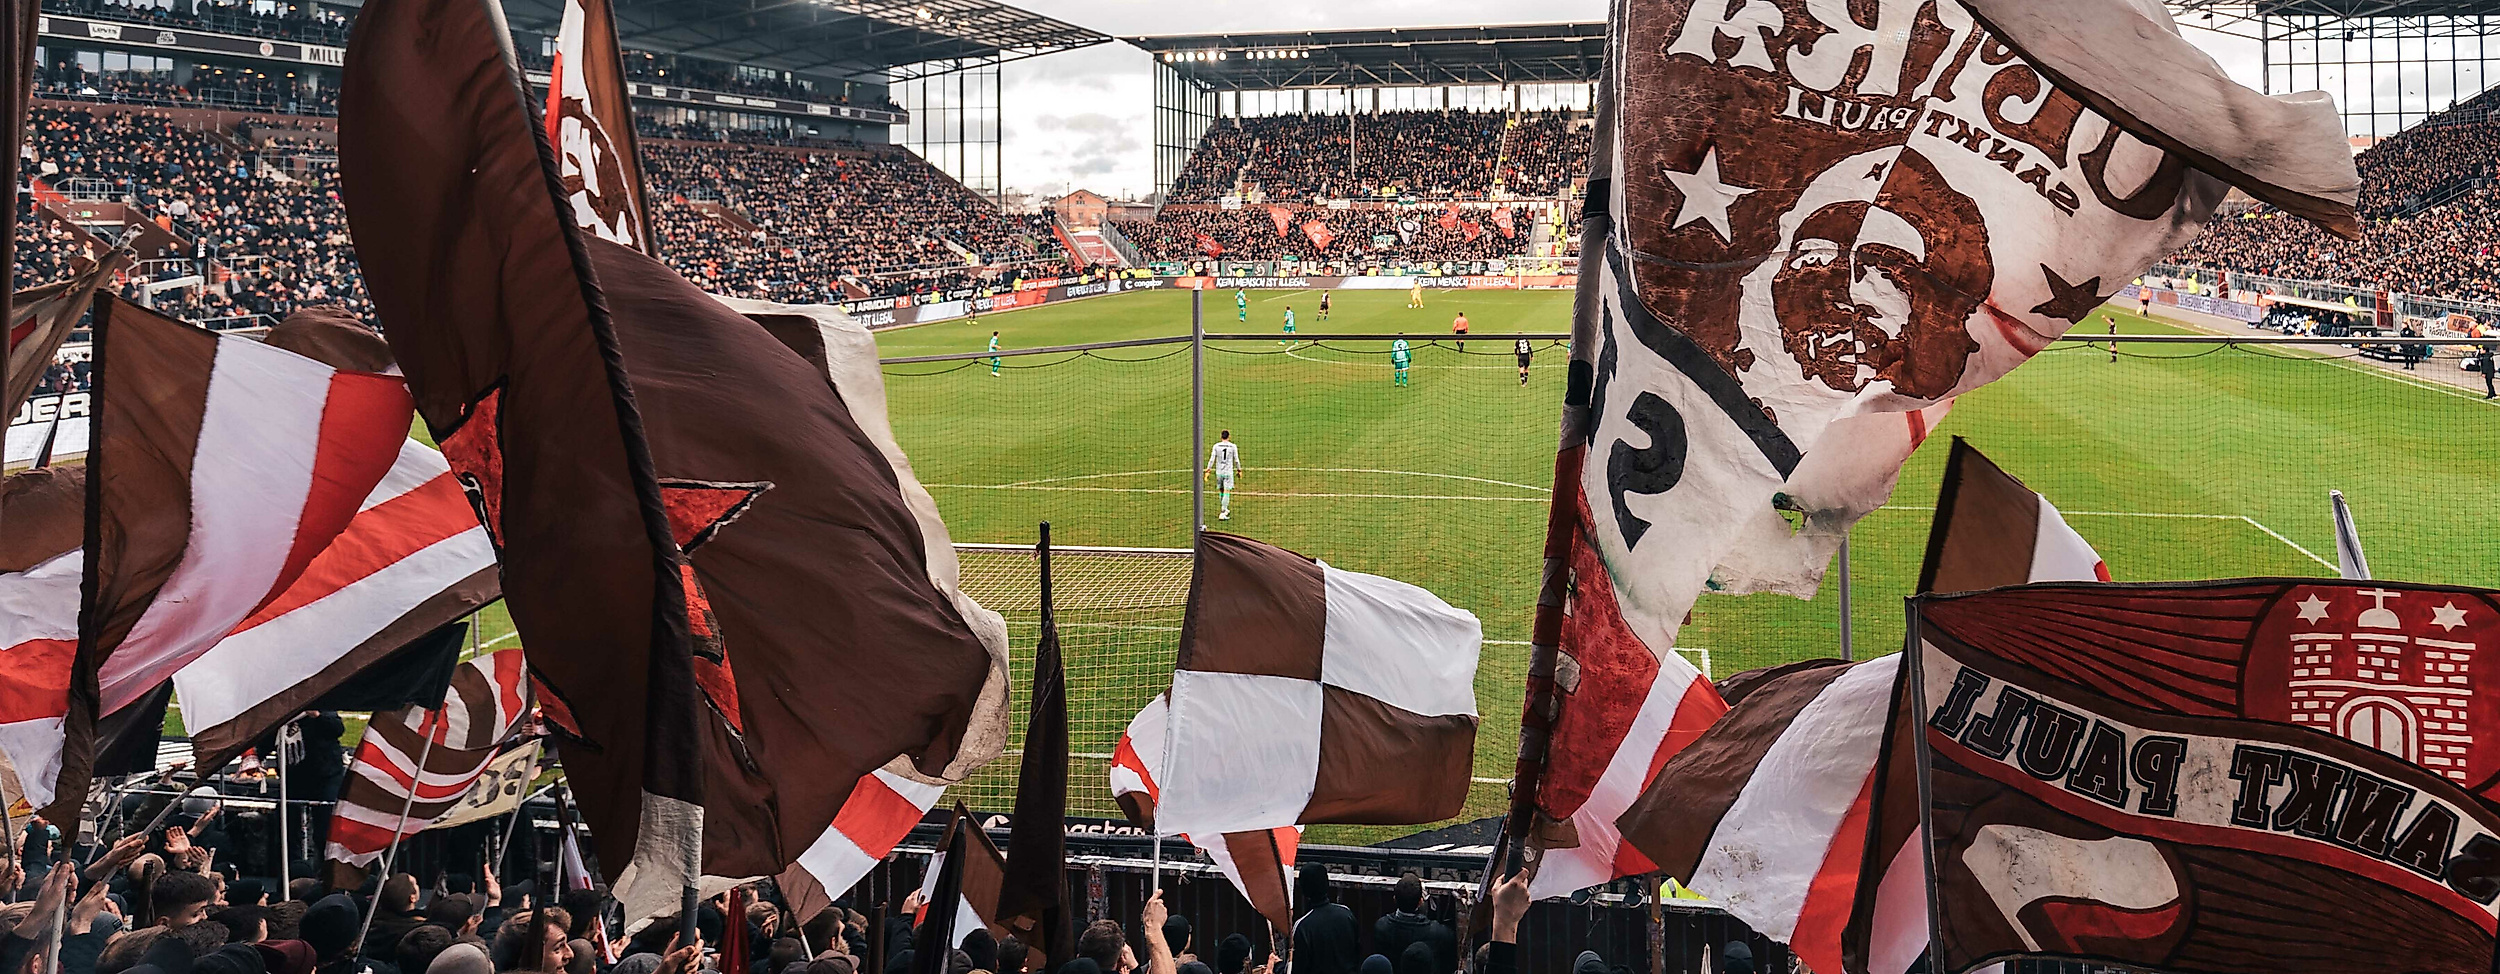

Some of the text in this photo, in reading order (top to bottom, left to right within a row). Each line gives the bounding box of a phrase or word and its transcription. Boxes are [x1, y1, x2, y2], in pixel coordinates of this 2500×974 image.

[309, 47, 346, 63] MILL
[1437, 277, 1468, 287] MENSCH
[856, 298, 895, 312] ARMOUR
[1222, 447, 1228, 461] 1
